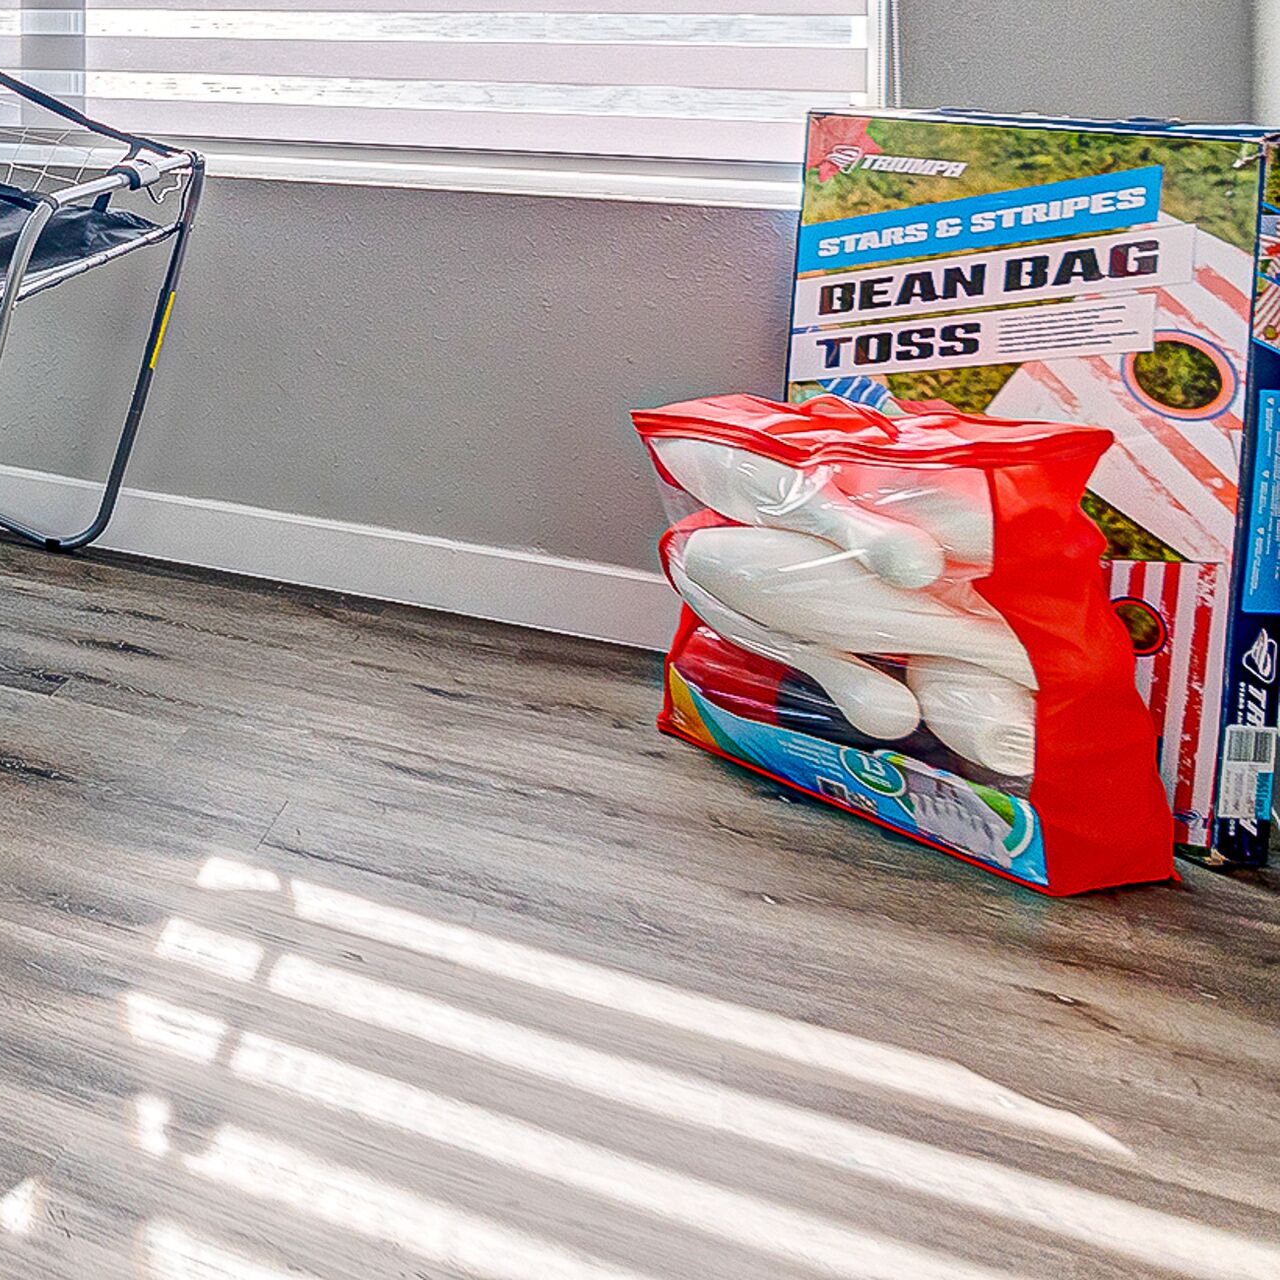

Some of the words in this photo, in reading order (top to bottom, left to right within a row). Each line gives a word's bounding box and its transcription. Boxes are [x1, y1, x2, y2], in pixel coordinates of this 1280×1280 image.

[861, 154, 967, 178] TRIUMPH
[818, 220, 930, 258] STARS
[934, 215, 963, 239] &
[970, 186, 1147, 235] STRIPES
[817, 263, 987, 316] BEAN
[1004, 238, 1161, 293] BAG
[815, 322, 982, 370] TOSS
